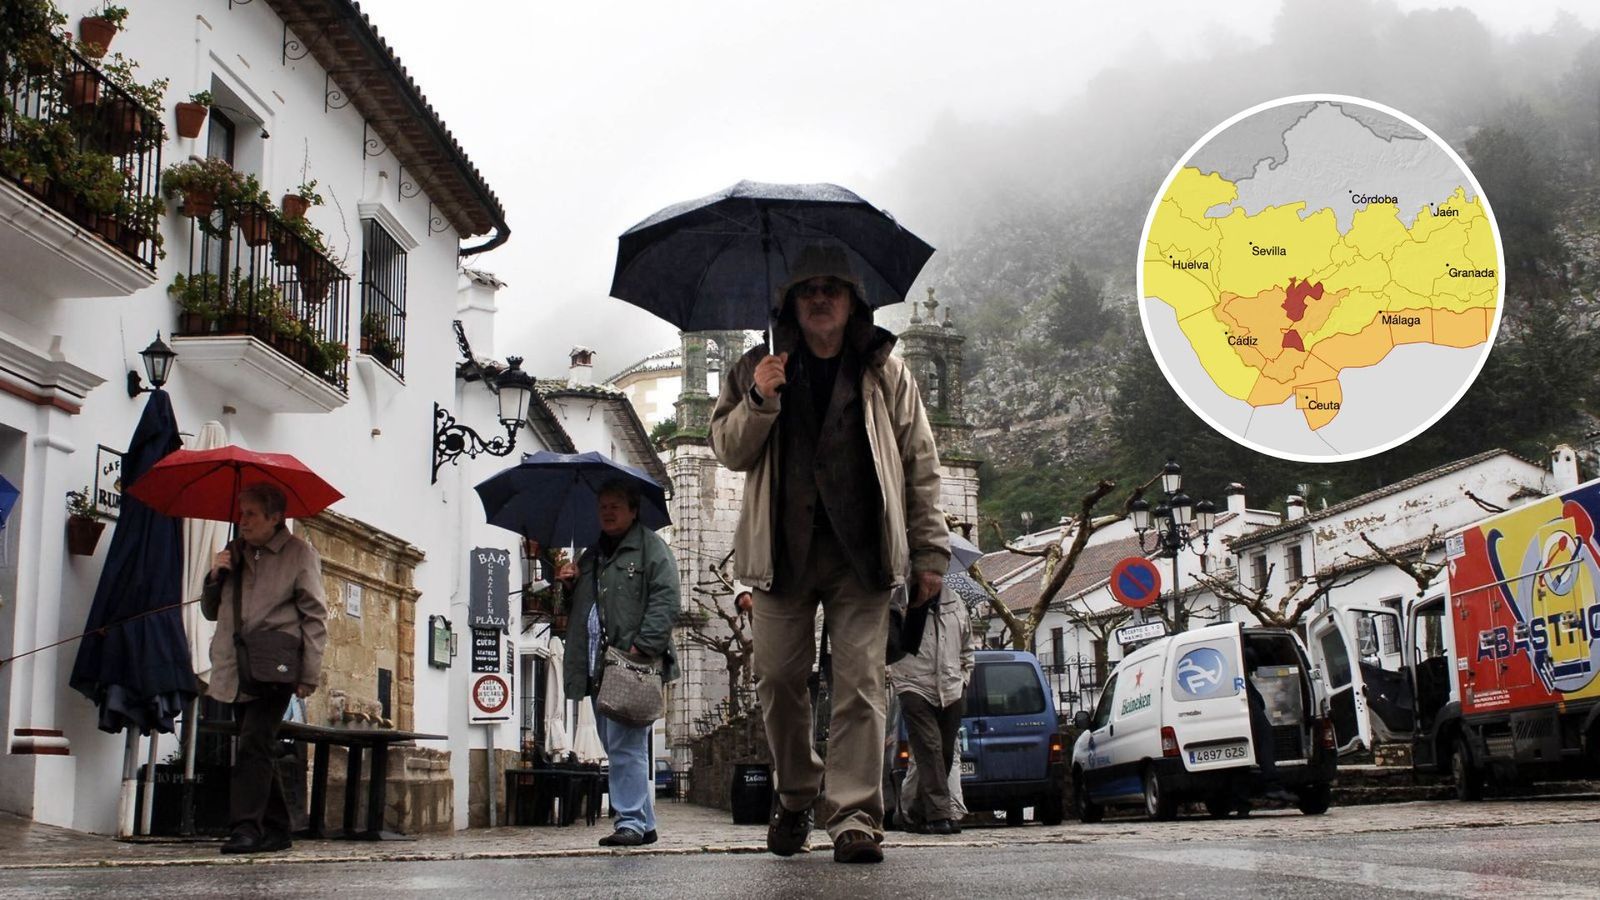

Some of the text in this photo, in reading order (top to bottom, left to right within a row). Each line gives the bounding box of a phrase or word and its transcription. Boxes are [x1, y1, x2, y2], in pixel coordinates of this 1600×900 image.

[103, 461, 120, 476] CAF
[478, 552, 506, 566] BAR
[475, 614, 506, 626] PLAZA
[1121, 693, 1151, 716] Heineken
[1197, 746, 1246, 761] 4897 GZS
